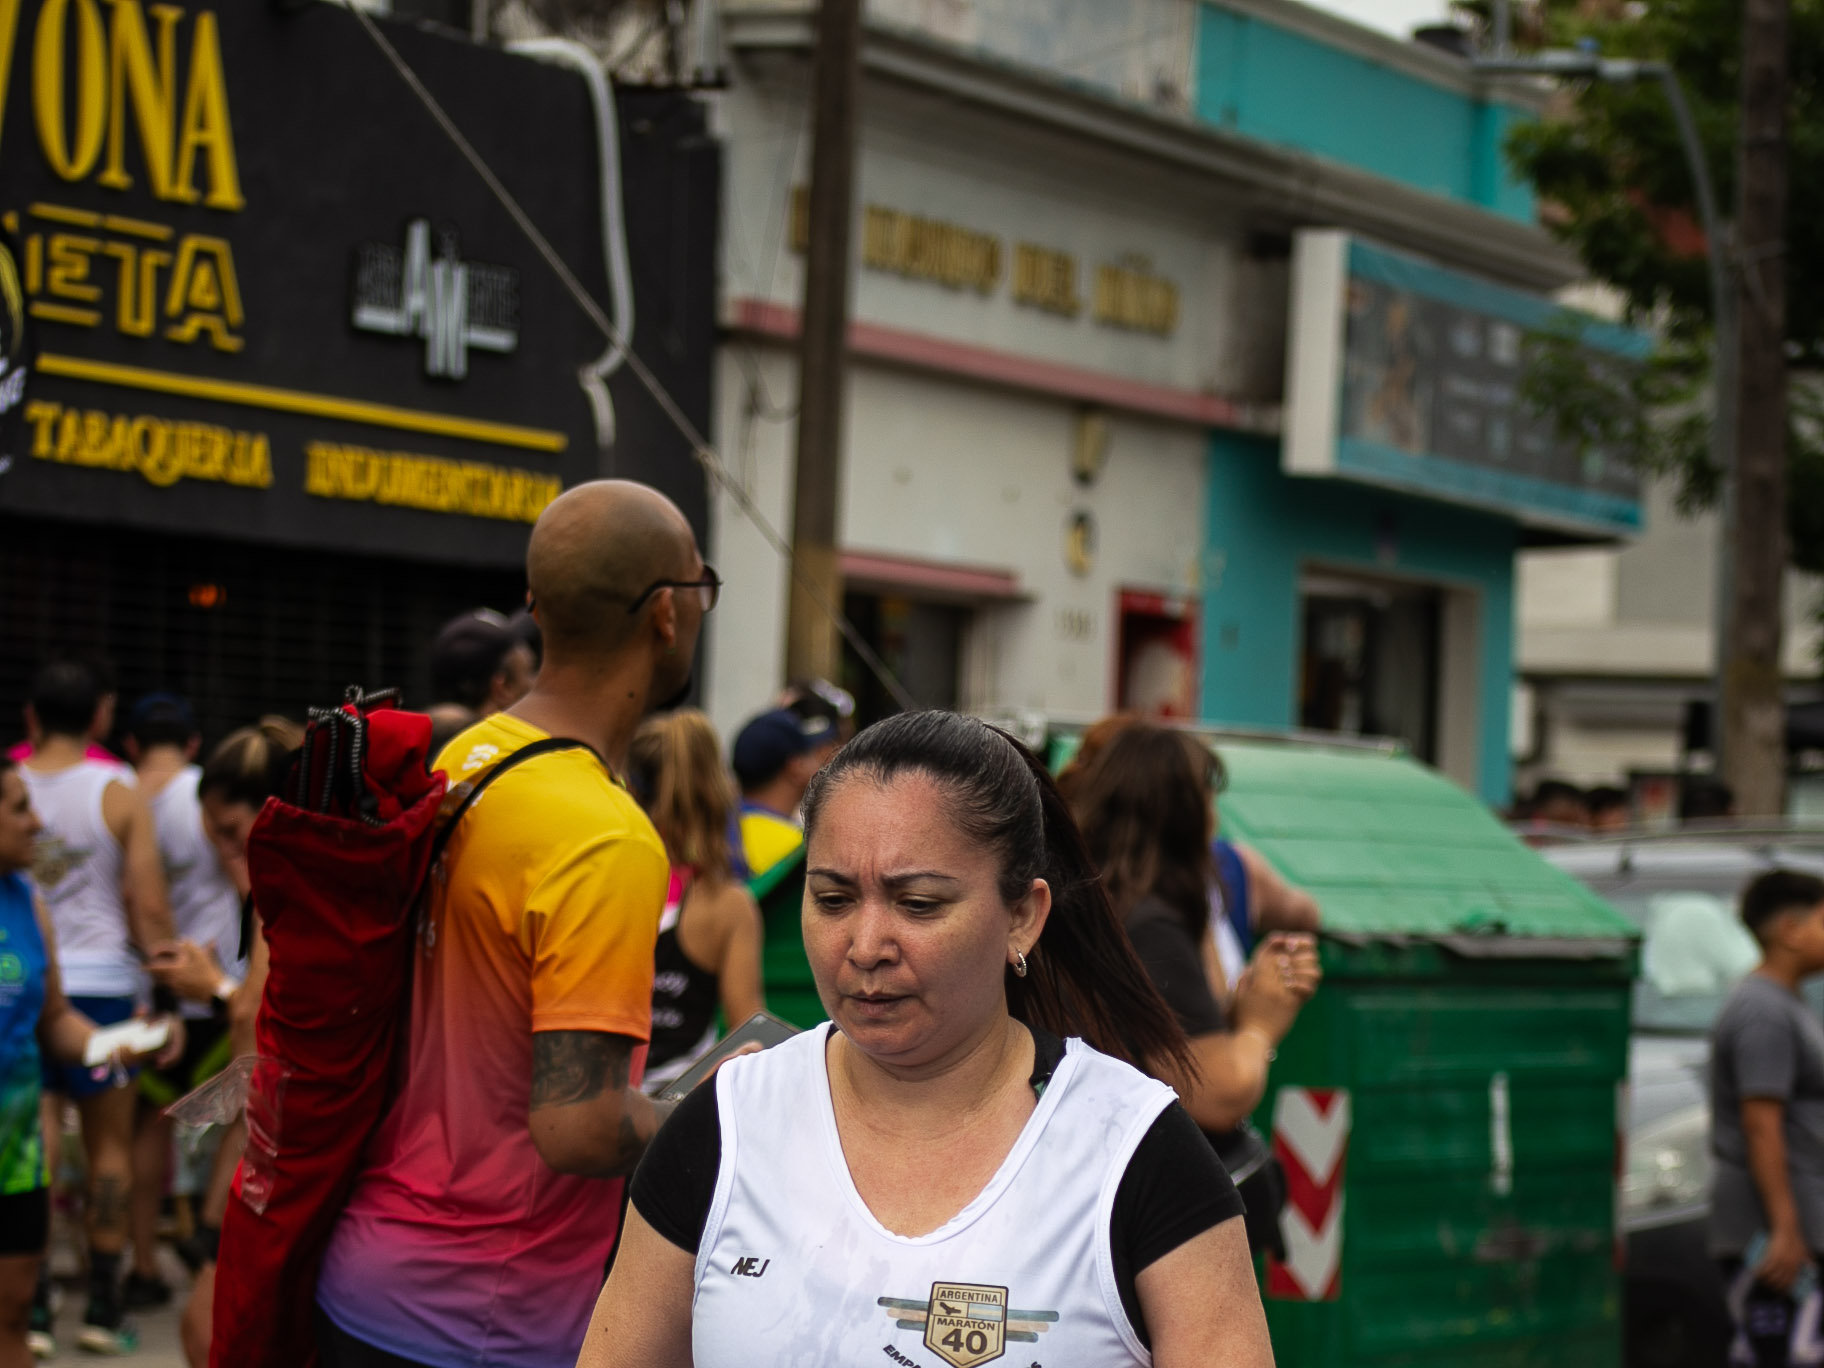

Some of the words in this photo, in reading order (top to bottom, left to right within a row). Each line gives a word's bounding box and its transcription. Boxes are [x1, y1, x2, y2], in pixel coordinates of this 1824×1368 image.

[0, 0, 245, 211] ONA
[2, 203, 244, 352] ETA
[730, 1256, 770, 1278] NEJ
[940, 1290, 998, 1304] ARGENTINA
[936, 1317, 995, 1331] MARATÓN
[941, 1328, 988, 1355] 40
